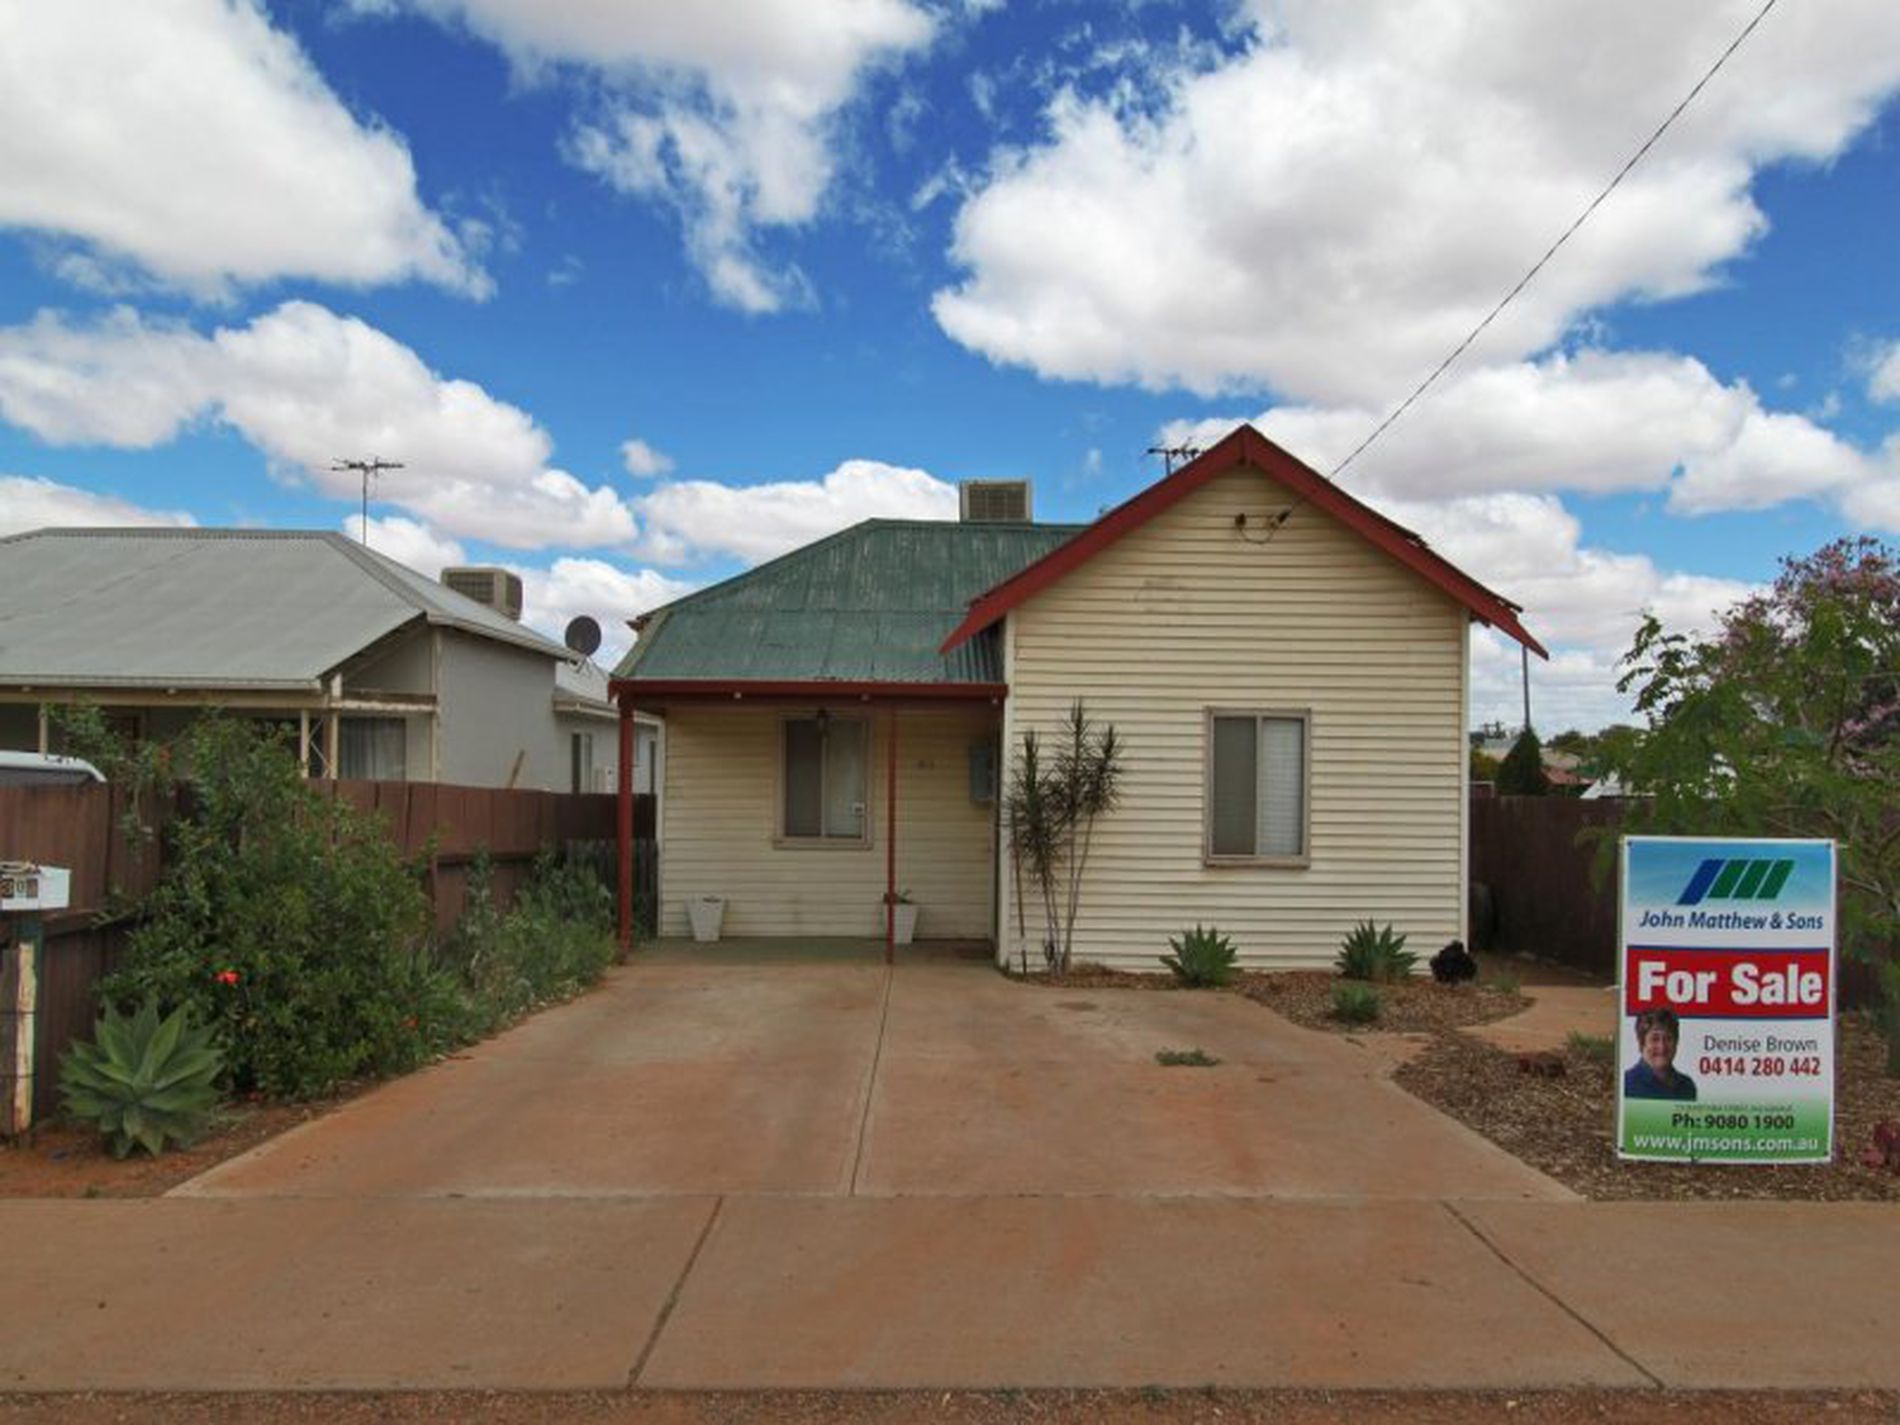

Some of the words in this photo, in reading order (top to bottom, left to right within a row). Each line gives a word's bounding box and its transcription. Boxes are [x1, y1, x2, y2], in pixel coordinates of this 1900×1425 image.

[1639, 911, 1685, 928] John
[1688, 911, 1768, 929] Matthew
[1769, 912, 1783, 929] &
[1785, 912, 1824, 930] Sons
[1638, 960, 1718, 1004] For
[1730, 962, 1823, 1005] Sale
[1703, 1035, 1762, 1051] Denise
[1766, 1036, 1818, 1051] Brown
[1699, 1056, 1745, 1075] 0414
[1752, 1057, 1785, 1076] 280
[1790, 1057, 1821, 1076] 442
[1672, 1113, 1701, 1128] Ph:
[1705, 1114, 1749, 1130] 9080
[1755, 1114, 1795, 1130] 1900
[1633, 1132, 1819, 1154] www.jmsons.com.au
